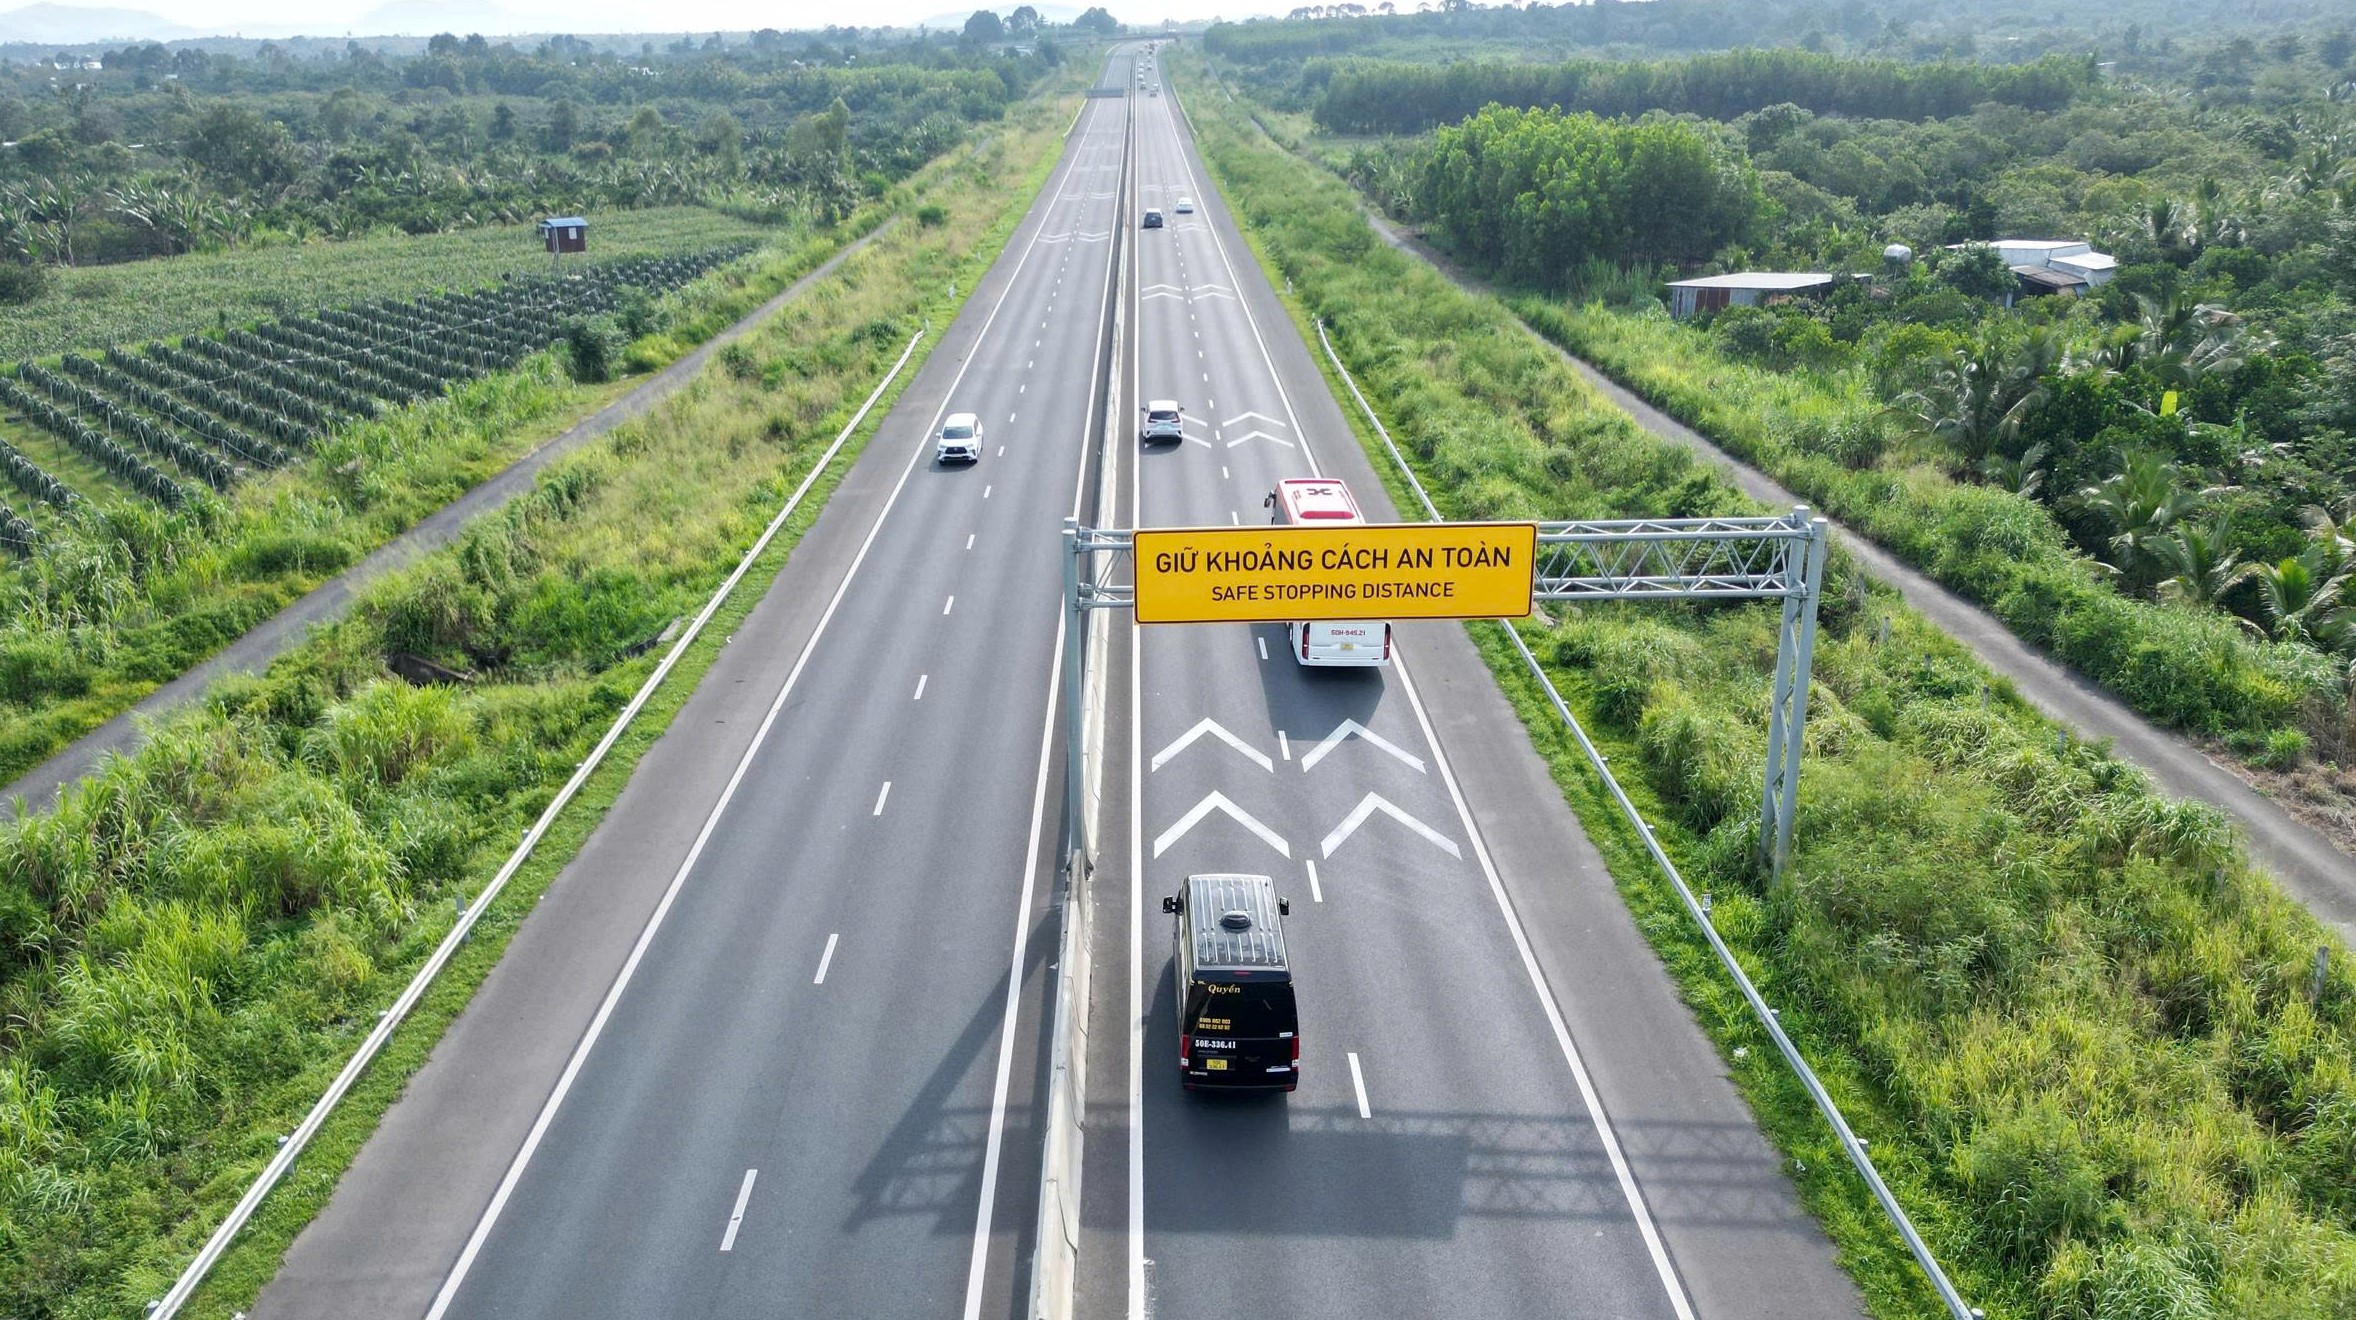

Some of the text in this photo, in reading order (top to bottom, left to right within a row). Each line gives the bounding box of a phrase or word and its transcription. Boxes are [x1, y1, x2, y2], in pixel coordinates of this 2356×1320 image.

[1156, 540, 1511, 573] GIỮ KHOẢNG CÁCH AN TOÀN
[1212, 581, 1455, 602] SAFE STOPPING DISTANCE
[1195, 1039, 1236, 1049] 50E-336.41
